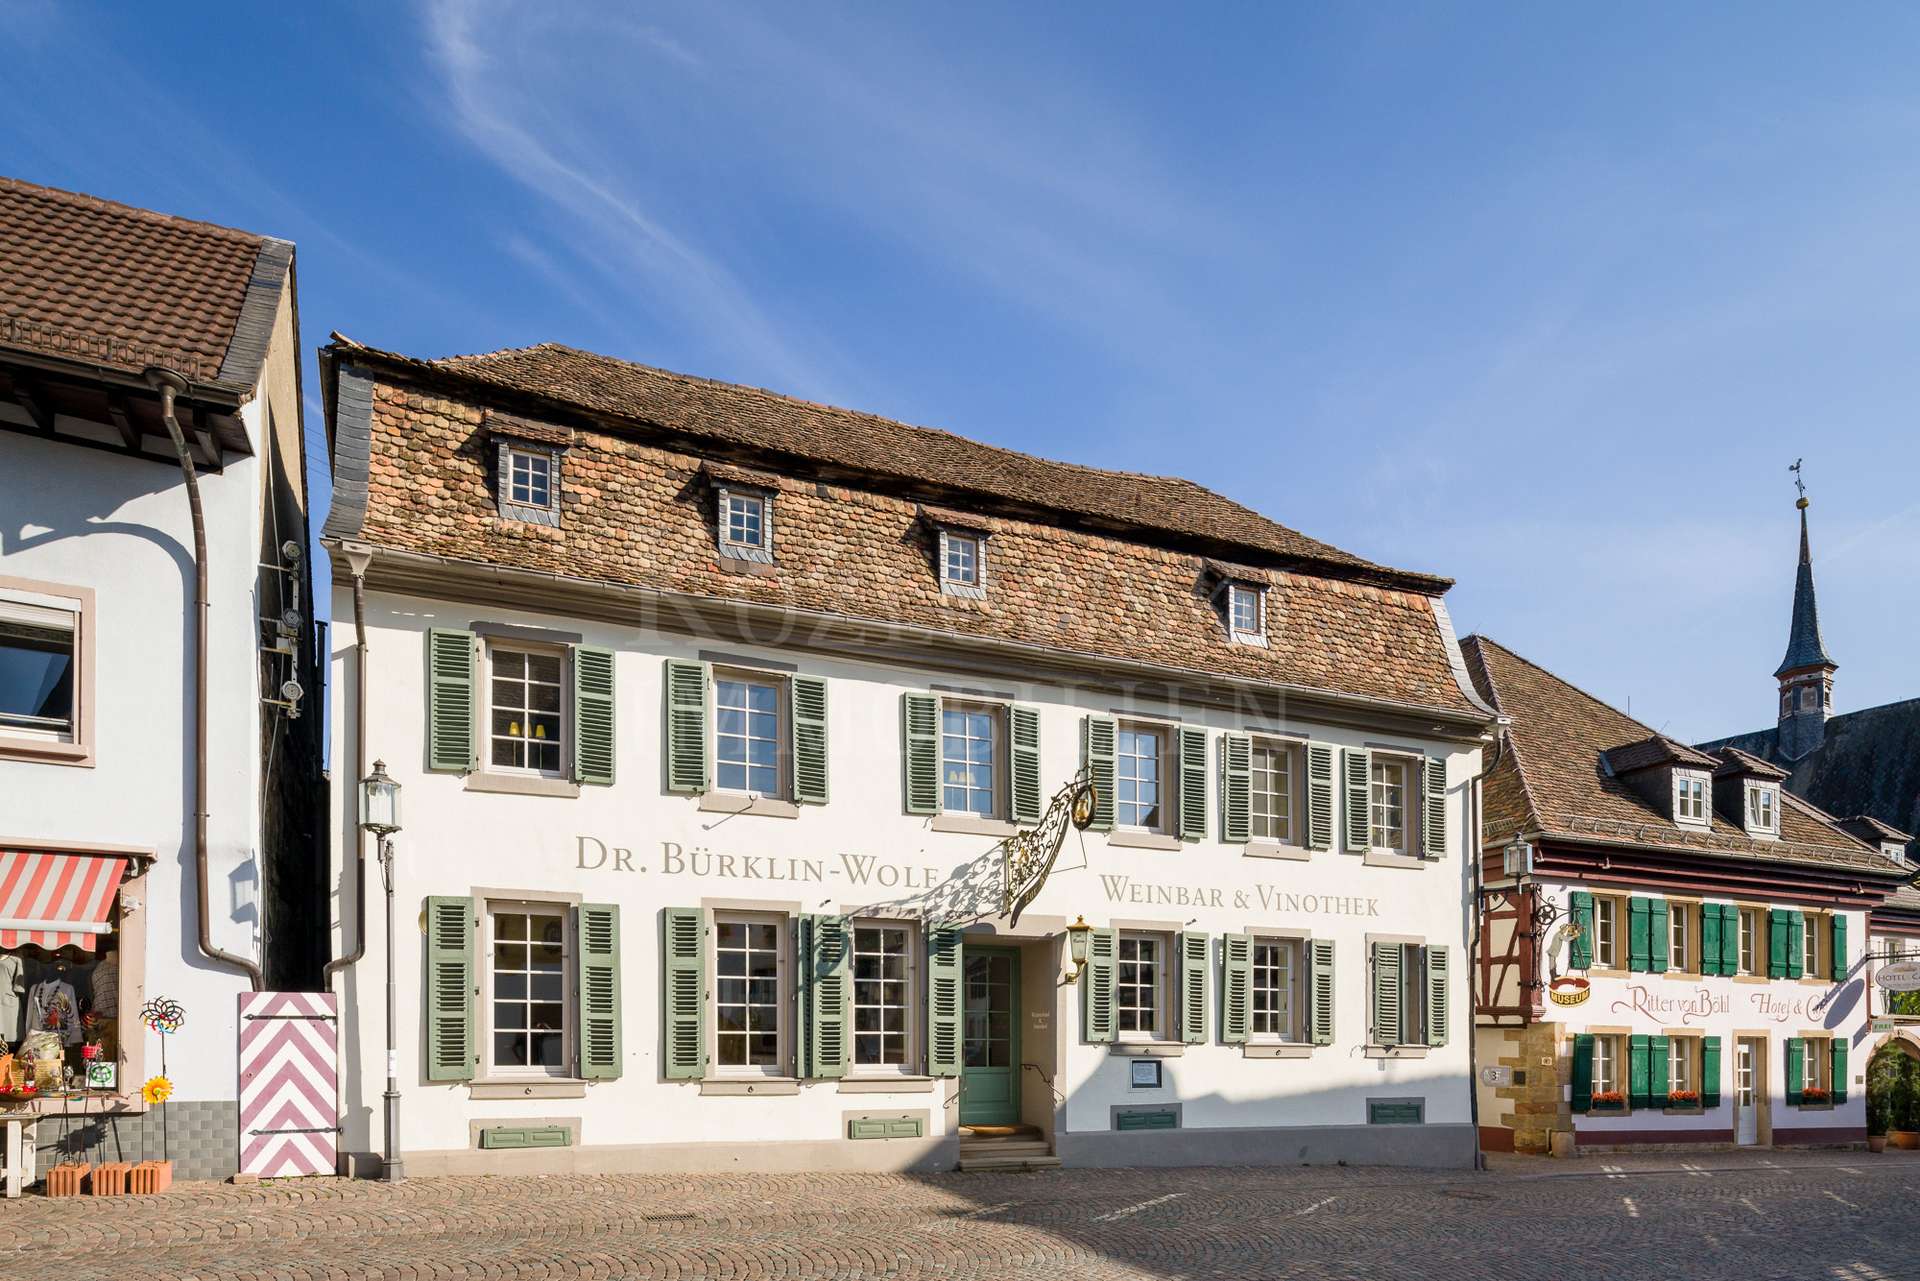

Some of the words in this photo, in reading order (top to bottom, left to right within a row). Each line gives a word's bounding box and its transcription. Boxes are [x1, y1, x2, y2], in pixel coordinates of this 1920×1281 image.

[576, 836, 647, 874] DR.
[661, 841, 939, 888] BÜRKLIN-WOLF
[1099, 874, 1225, 908] WEINBAR
[1234, 889, 1250, 909] &
[1255, 884, 1380, 917] VINOTHEK
[1551, 990, 1589, 1004] MUSEUM
[1611, 983, 1669, 1024] Ritter
[1677, 999, 1697, 1013] von
[1682, 986, 1729, 1025] Böhl
[1751, 993, 1791, 1023] Hotel
[1793, 999, 1802, 1015] &
